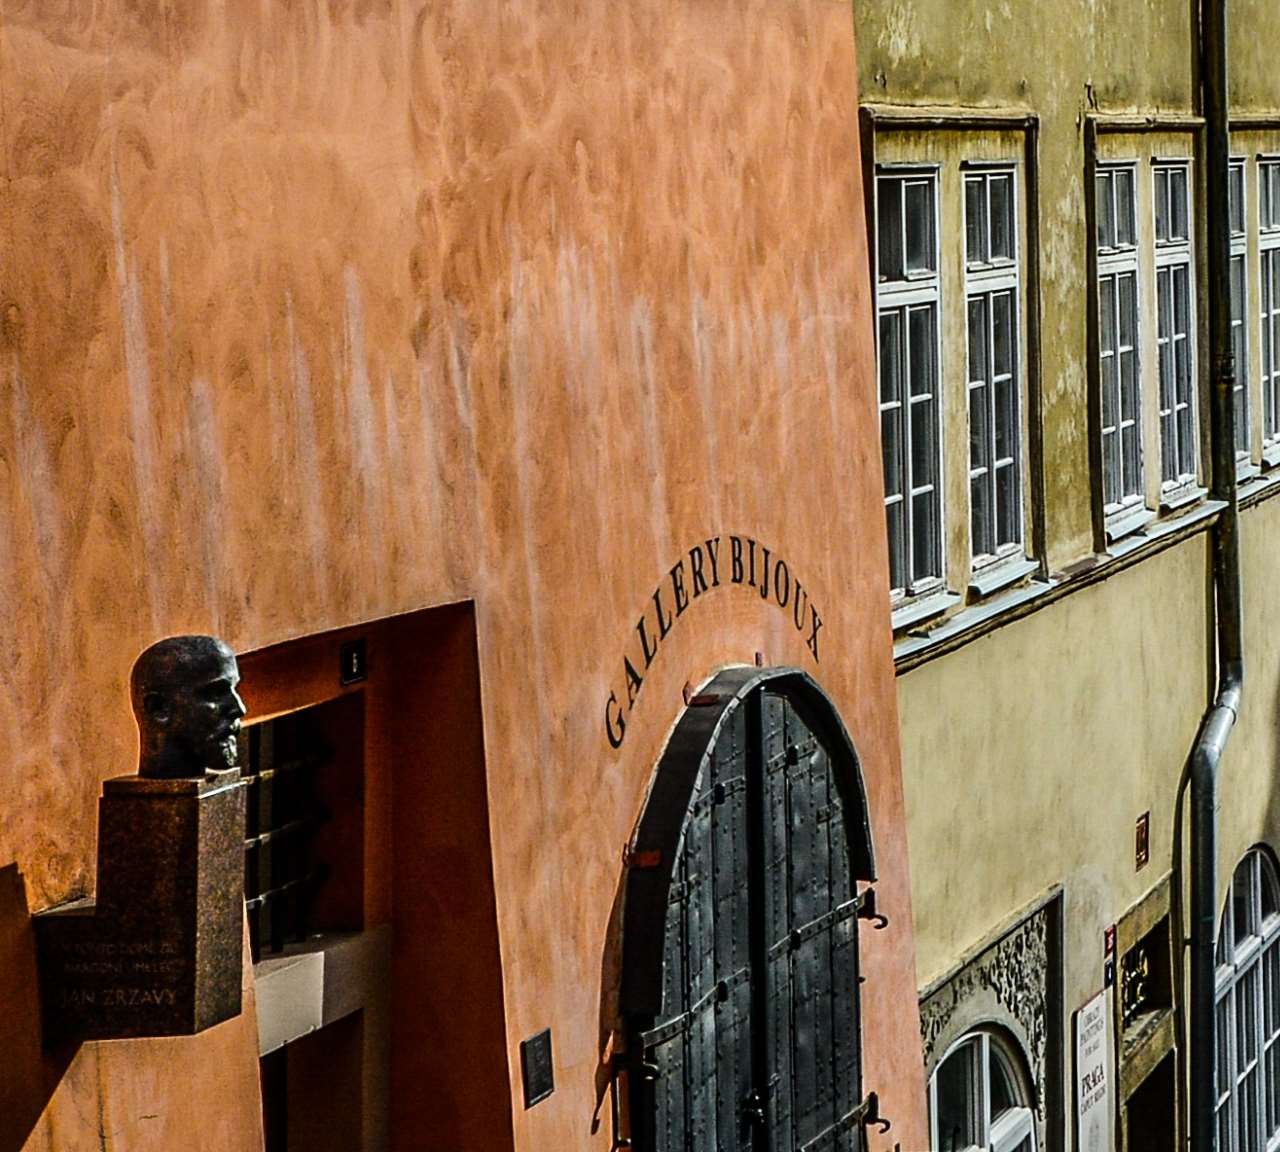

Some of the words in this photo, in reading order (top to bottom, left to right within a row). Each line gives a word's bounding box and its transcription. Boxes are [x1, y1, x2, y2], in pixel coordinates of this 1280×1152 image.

[604, 536, 722, 749] GALLERY
[729, 535, 824, 664] BIJOUX
[1081, 1063, 1105, 1098] PRAGA
